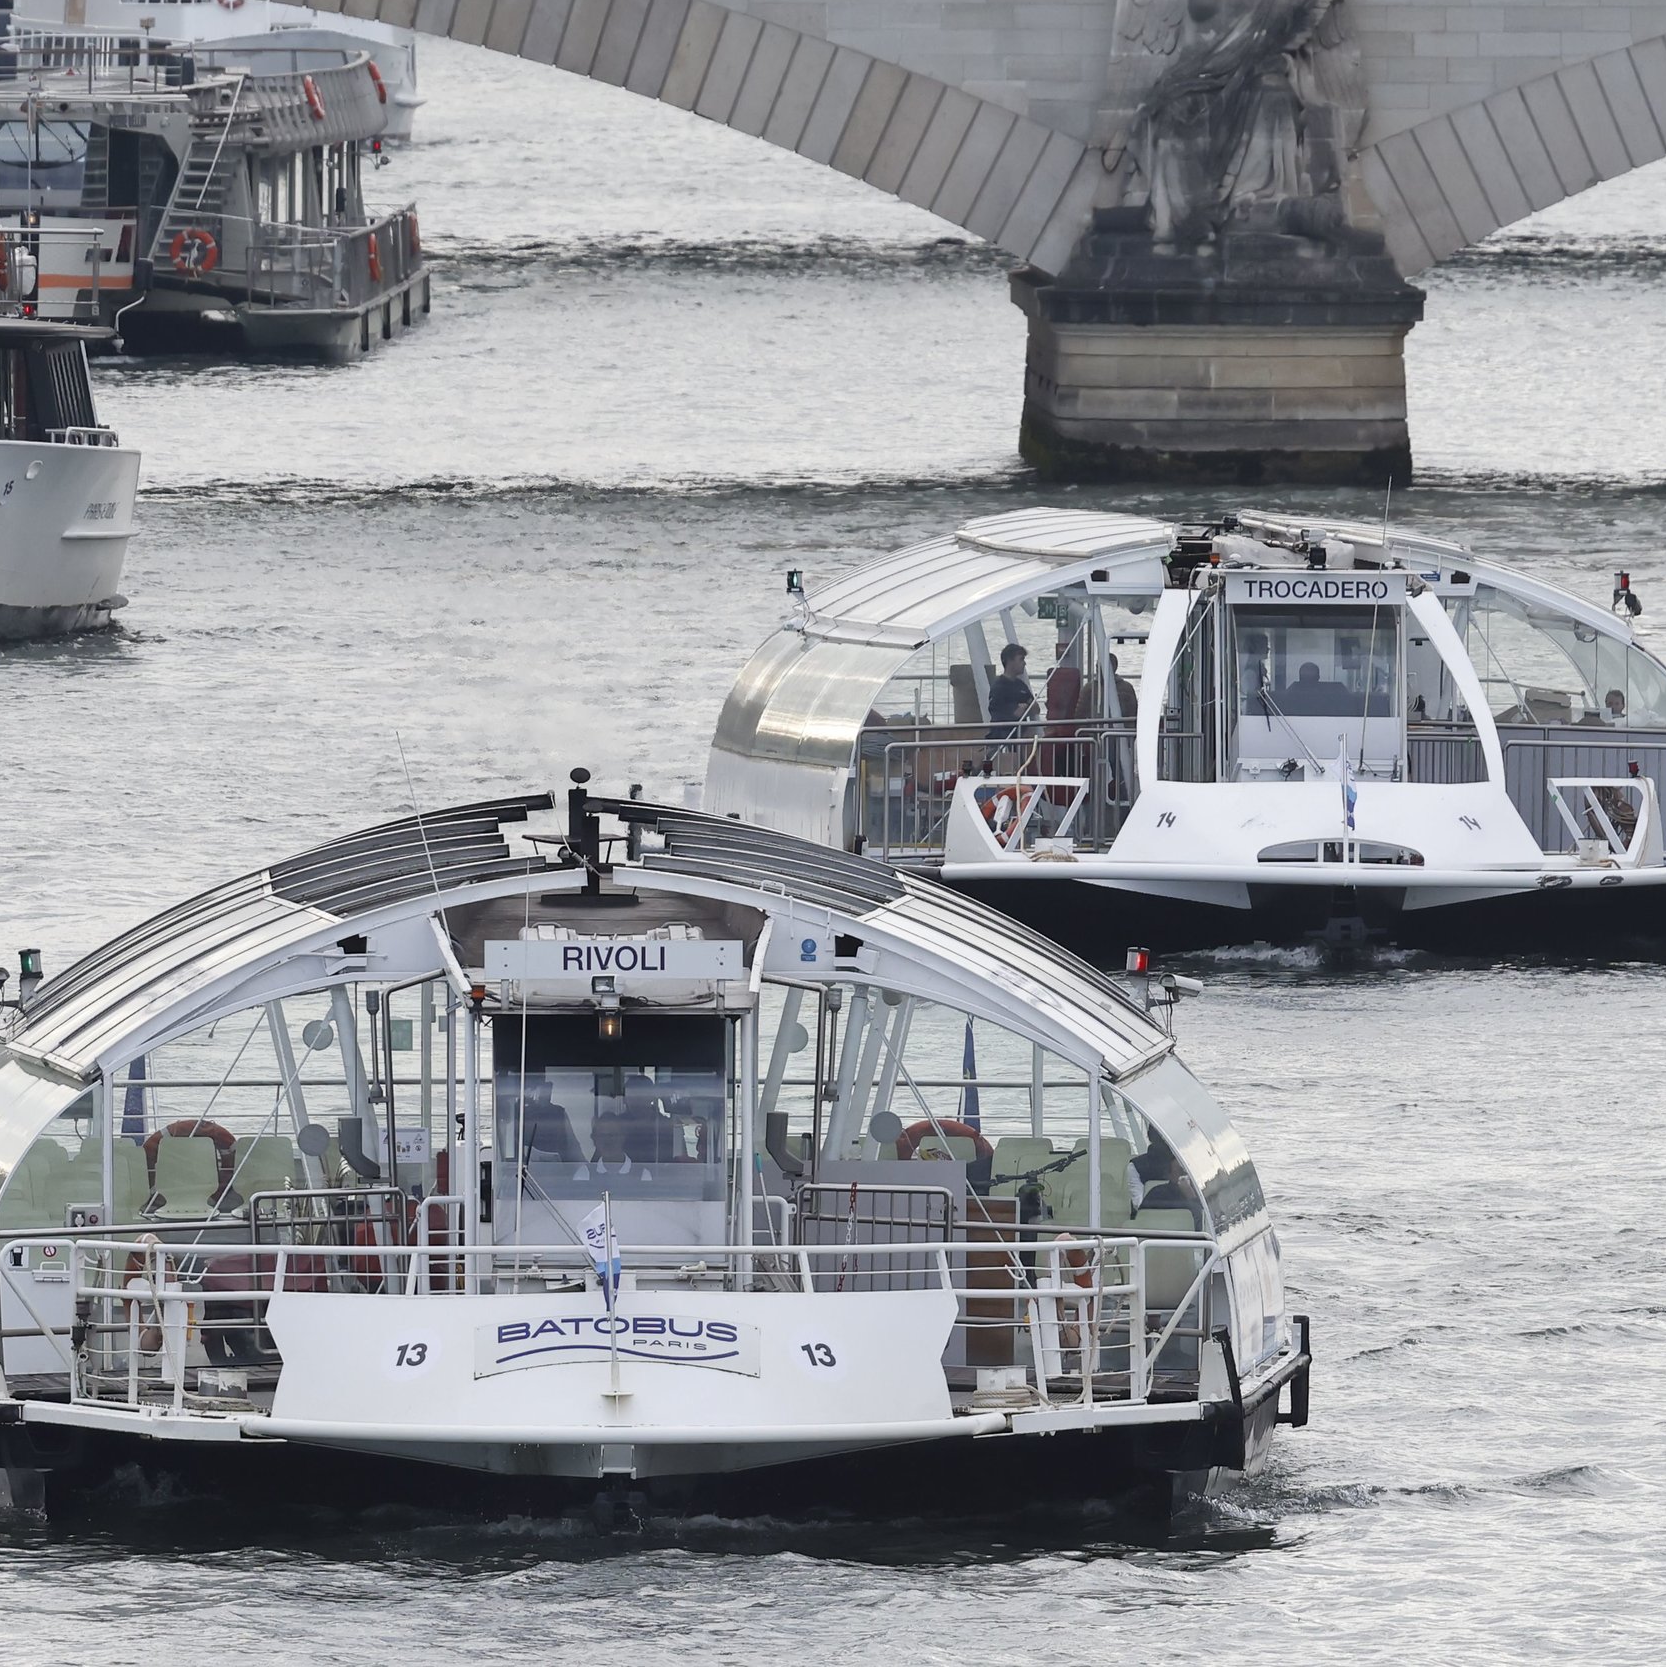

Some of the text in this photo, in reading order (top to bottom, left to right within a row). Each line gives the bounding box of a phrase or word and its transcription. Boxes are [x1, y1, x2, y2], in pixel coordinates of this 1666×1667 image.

[3, 480, 15, 496] 15
[1243, 580, 1388, 599] TROCADERO
[1155, 812, 1176, 828] 14
[1458, 815, 1482, 831] 14
[563, 945, 666, 971] RIVOLI
[497, 1316, 739, 1345] BATOBUS
[633, 1339, 707, 1351] PARIS
[396, 1343, 428, 1367] 13
[801, 1343, 837, 1368] 13
